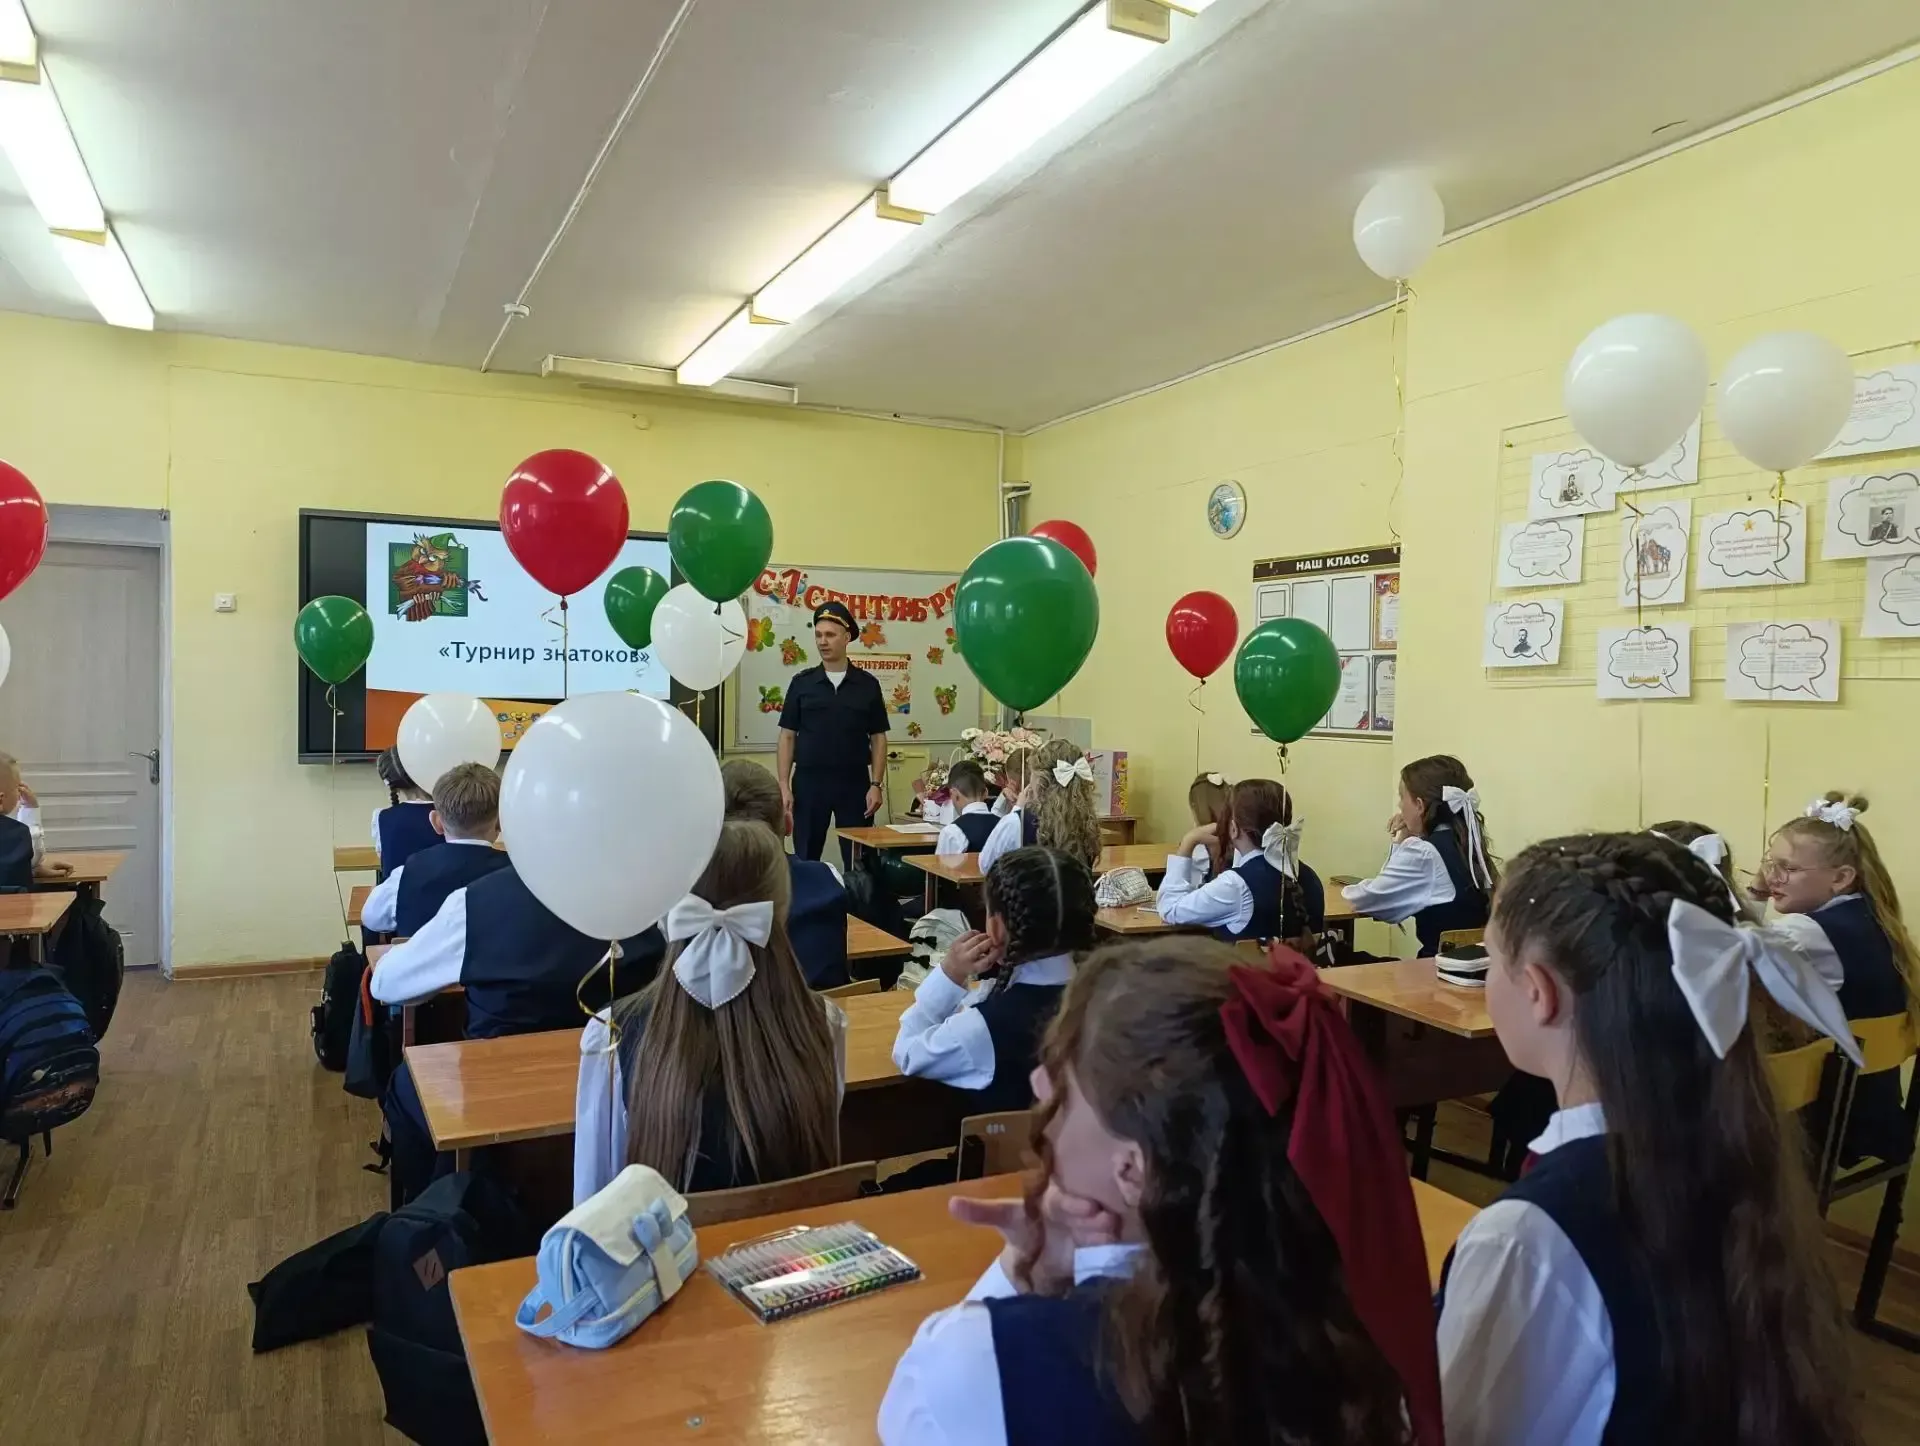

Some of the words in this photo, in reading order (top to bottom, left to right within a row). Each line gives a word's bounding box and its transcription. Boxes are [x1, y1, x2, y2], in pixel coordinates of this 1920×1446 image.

[1296, 558, 1322, 571] НАШ
[1327, 553, 1370, 568] КЛАСС
[781, 568, 801, 605] 1
[438, 641, 535, 663] «Турнир
[543, 647, 650, 663] знатоков»
